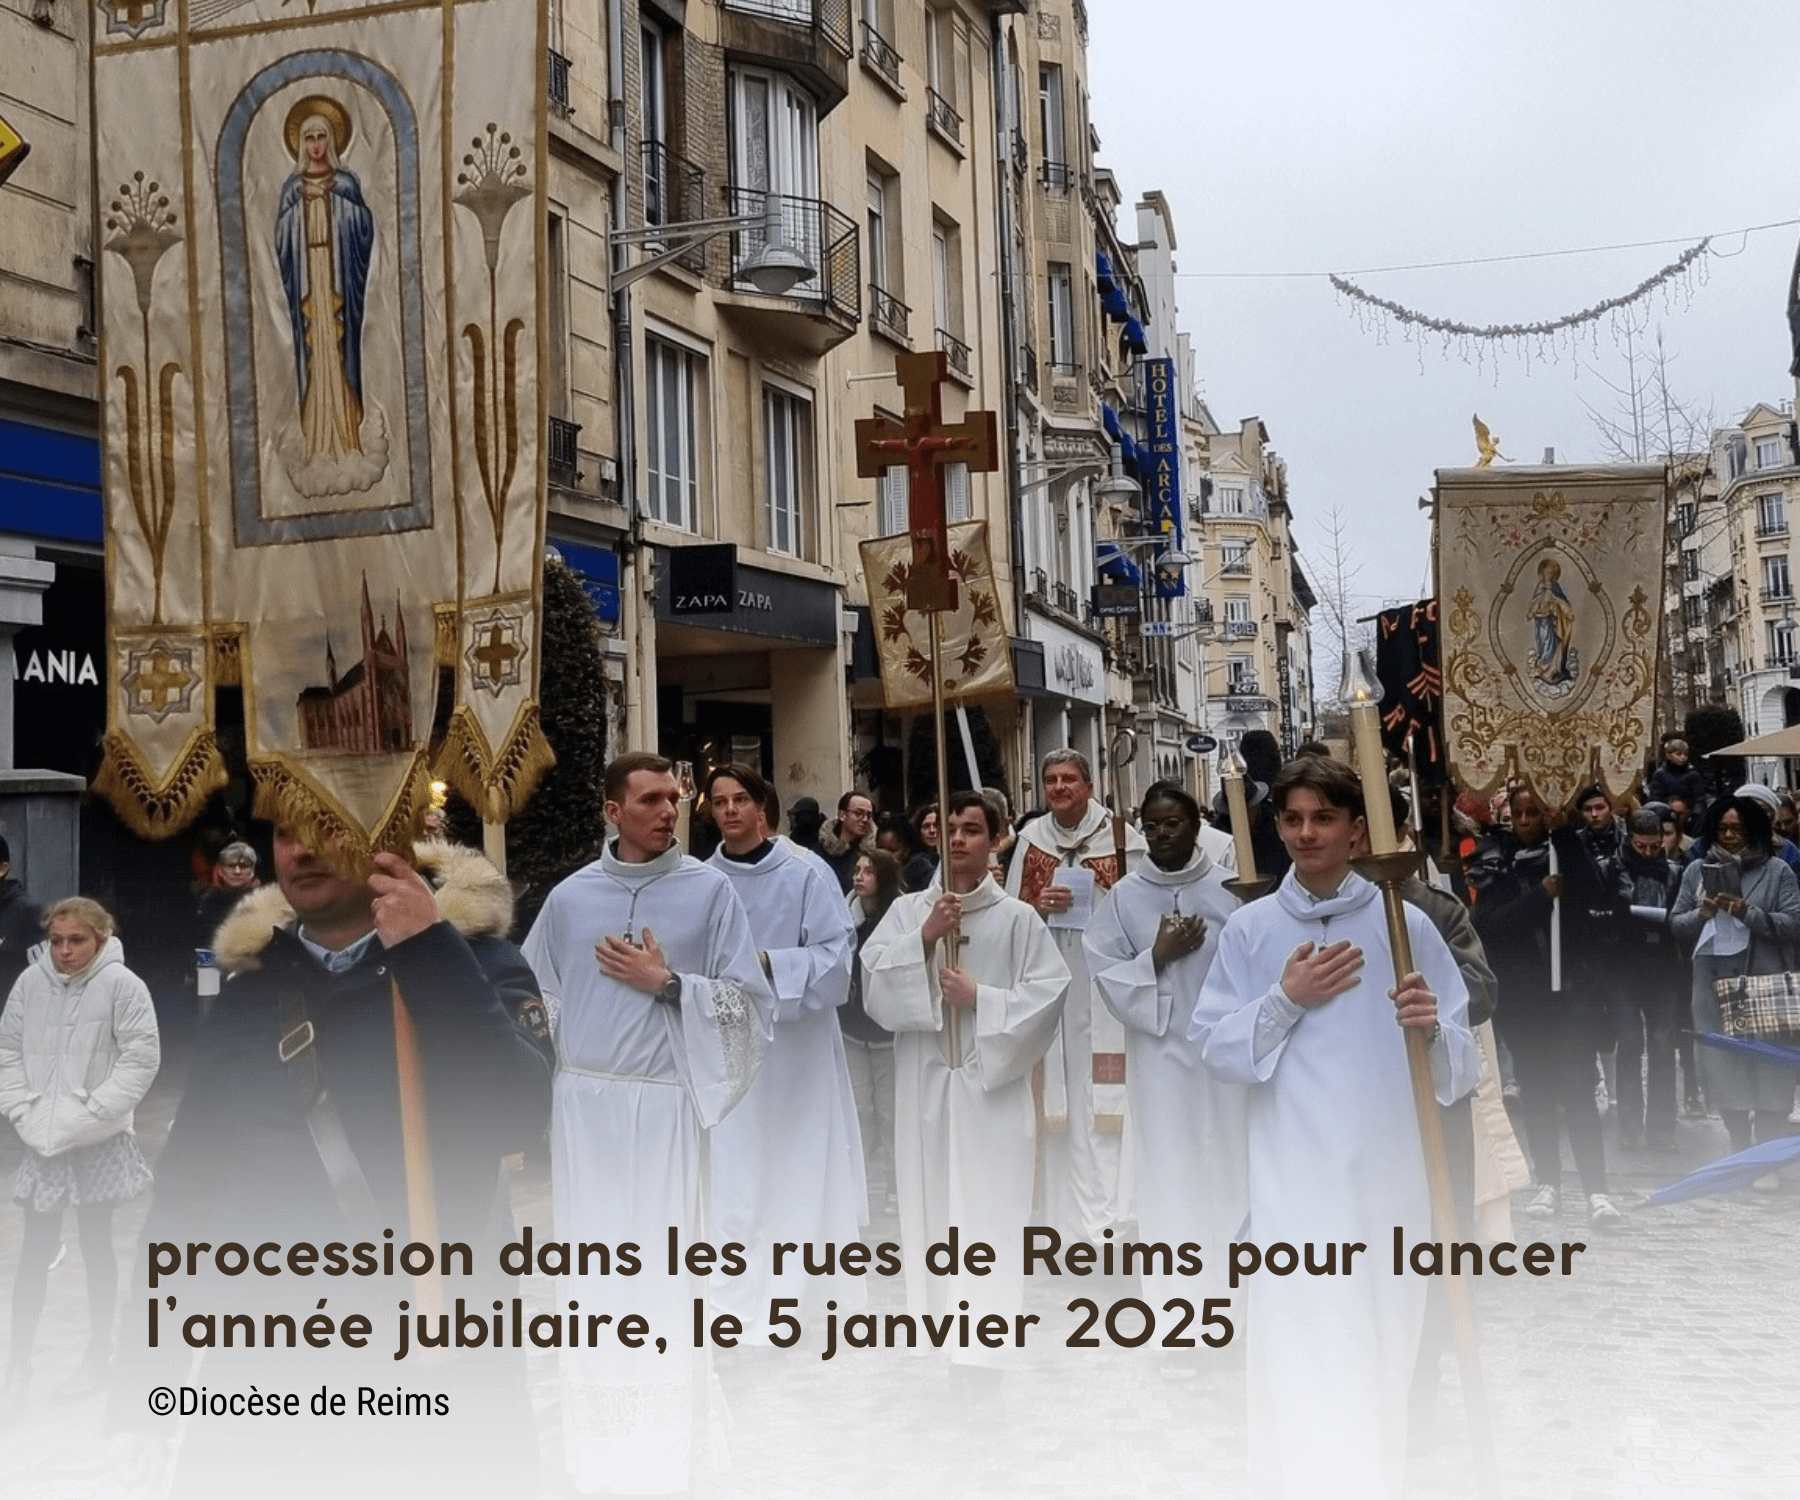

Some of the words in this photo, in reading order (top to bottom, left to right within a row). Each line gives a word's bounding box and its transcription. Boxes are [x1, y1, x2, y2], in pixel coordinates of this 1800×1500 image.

[1151, 364, 1169, 438] HOTEL
[1152, 443, 1173, 453] DES
[675, 594, 728, 609] ZAPA
[738, 590, 773, 611] ZAPA
[13, 648, 99, 686] ANIA
